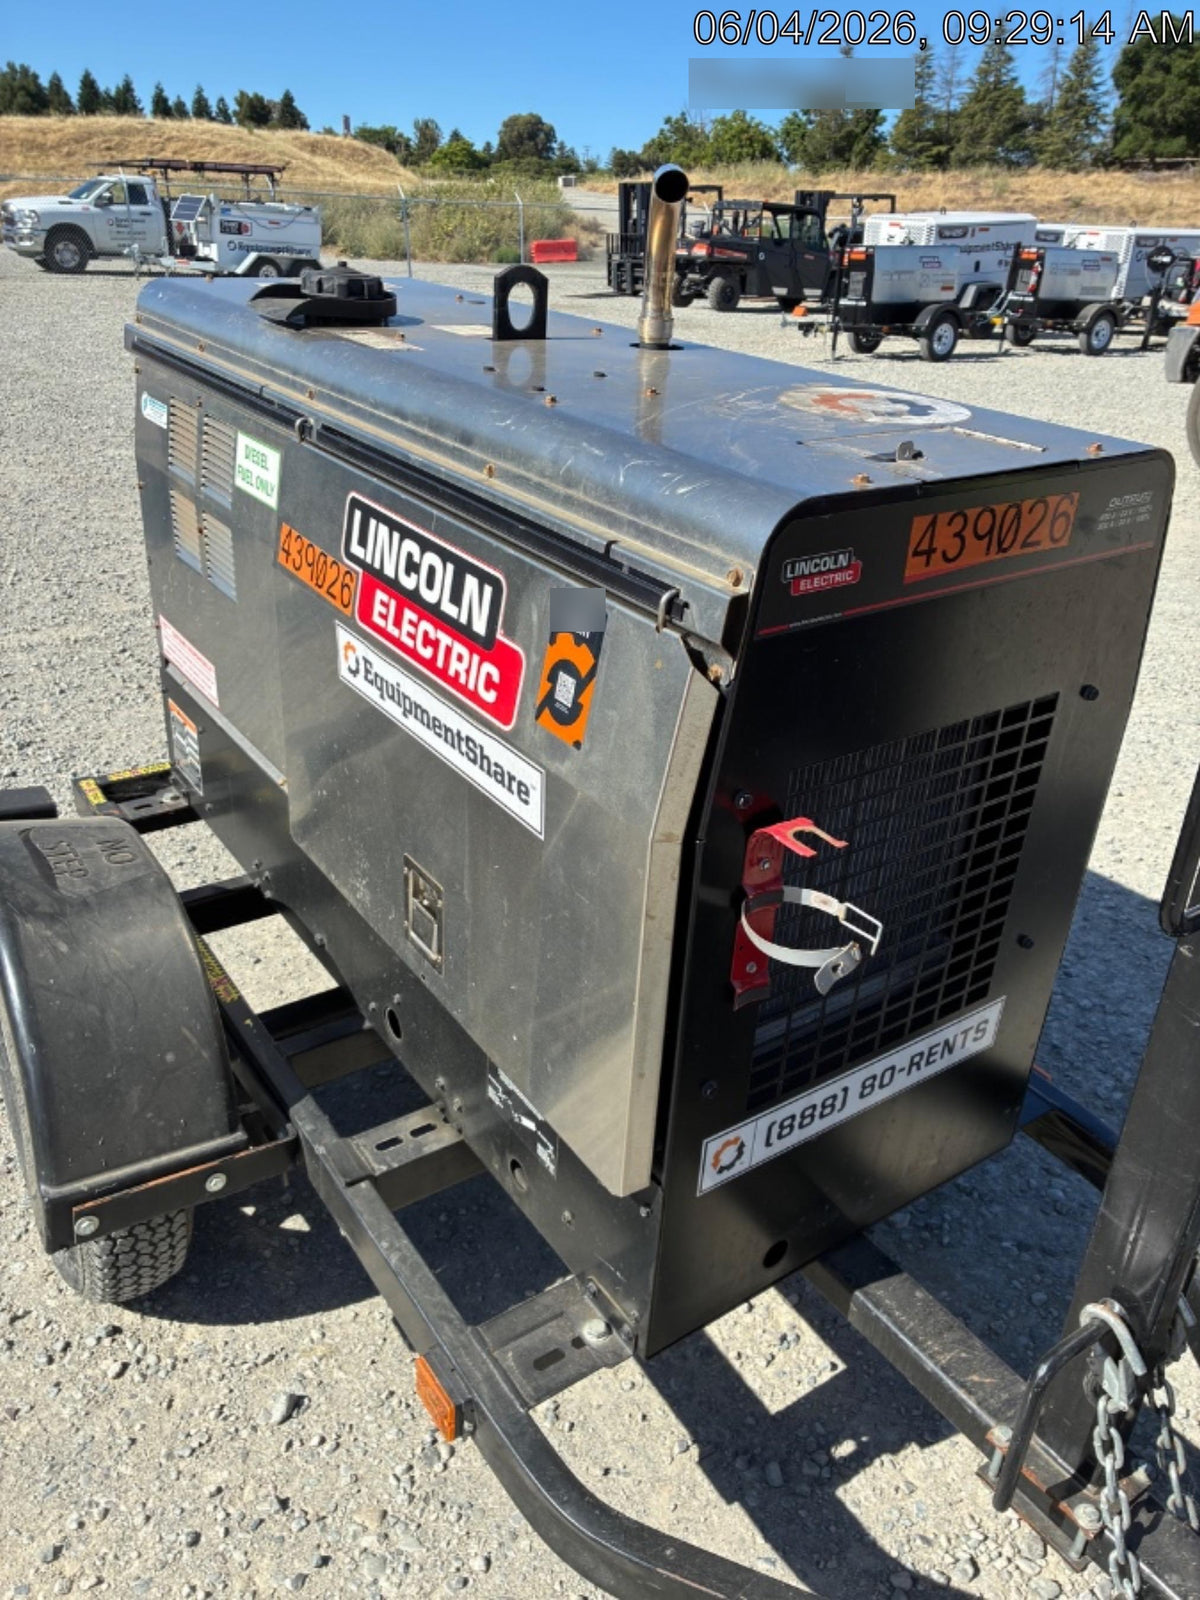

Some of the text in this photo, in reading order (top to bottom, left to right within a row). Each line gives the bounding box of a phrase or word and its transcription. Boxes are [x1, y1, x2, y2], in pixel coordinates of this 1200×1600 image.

[256, 475, 275, 497] ONLY
[280, 528, 355, 610] 439026
[786, 552, 850, 579] LINCOLN
[911, 493, 1075, 568] 439026
[349, 508, 494, 638] LINCOLN
[800, 570, 855, 591] ELECTRIC
[371, 588, 501, 705] ELECTRIC
[361, 655, 531, 807] EquipmentShare
[95, 839, 138, 865] NO
[764, 1018, 990, 1148] (888) 80-RENTS
